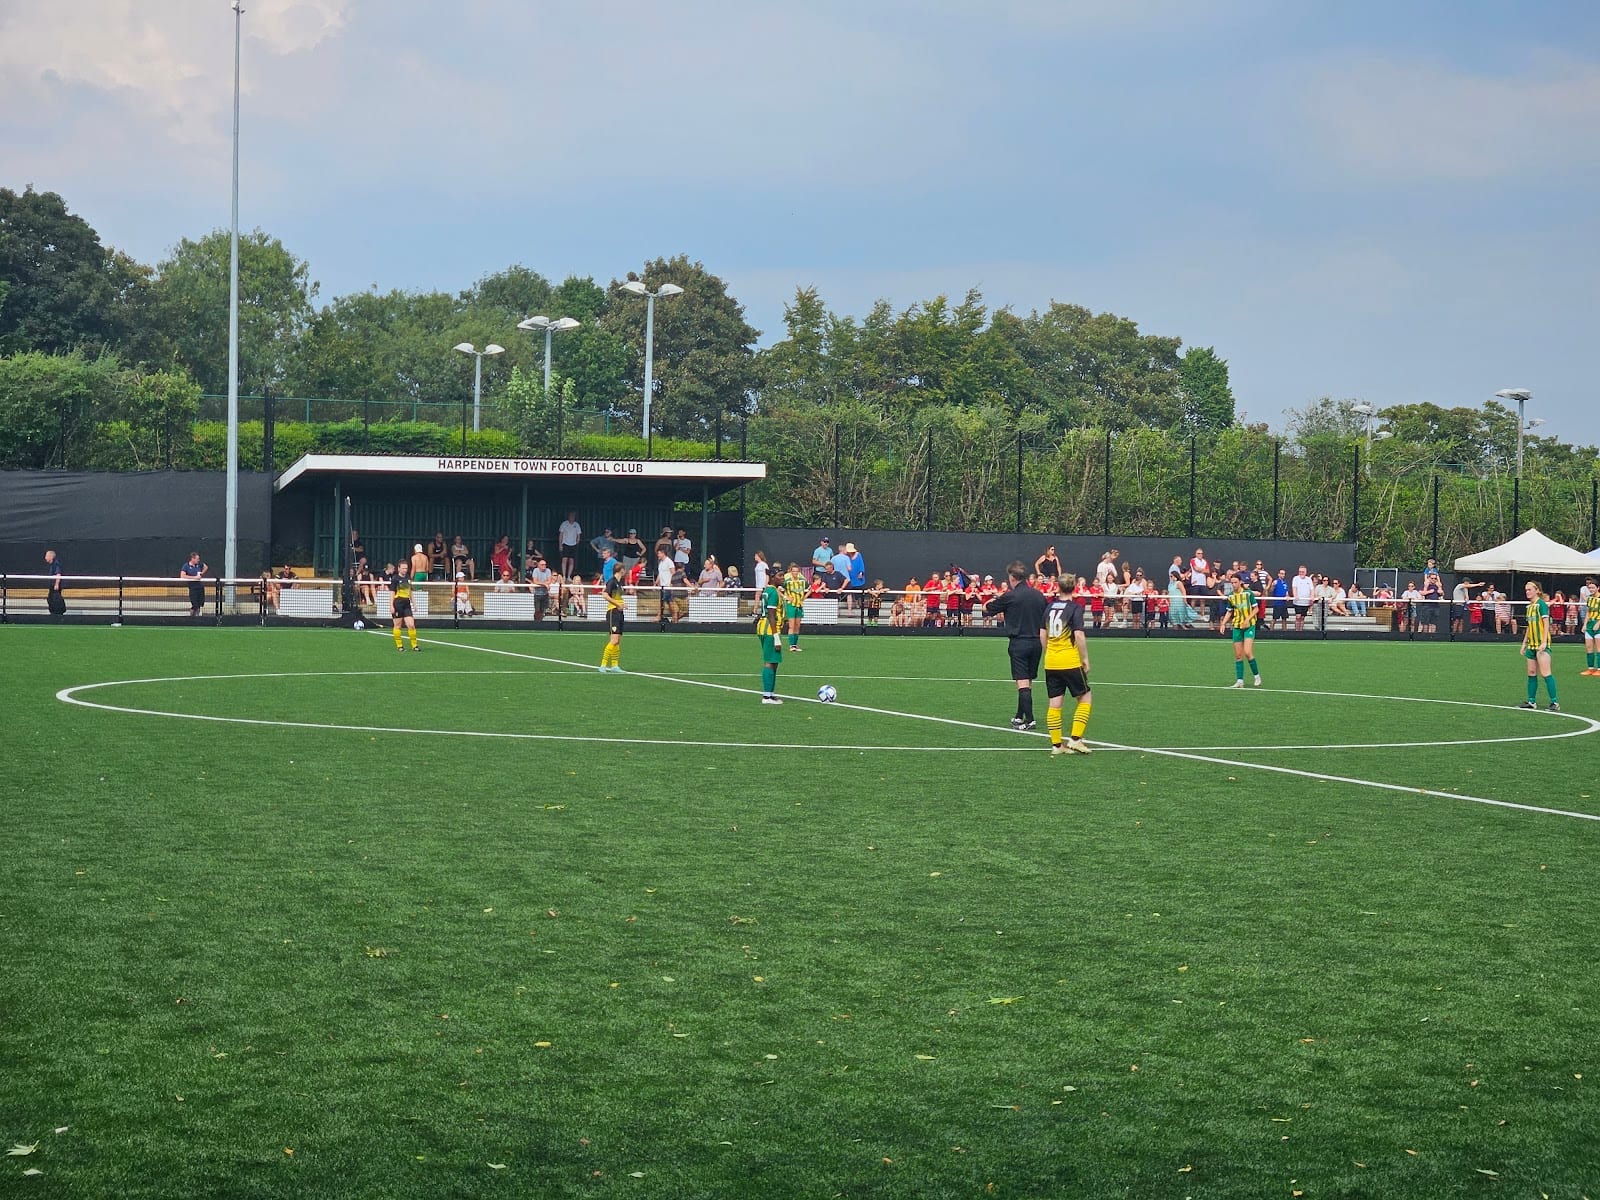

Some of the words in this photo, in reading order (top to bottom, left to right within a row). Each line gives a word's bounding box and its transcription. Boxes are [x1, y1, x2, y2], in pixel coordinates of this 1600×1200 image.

[438, 459, 509, 470] HARPENDEN
[514, 461, 547, 471] TOWN
[551, 462, 609, 472] FOOTBALL
[613, 463, 643, 473] CLUB
[1049, 609, 1064, 637] 16
